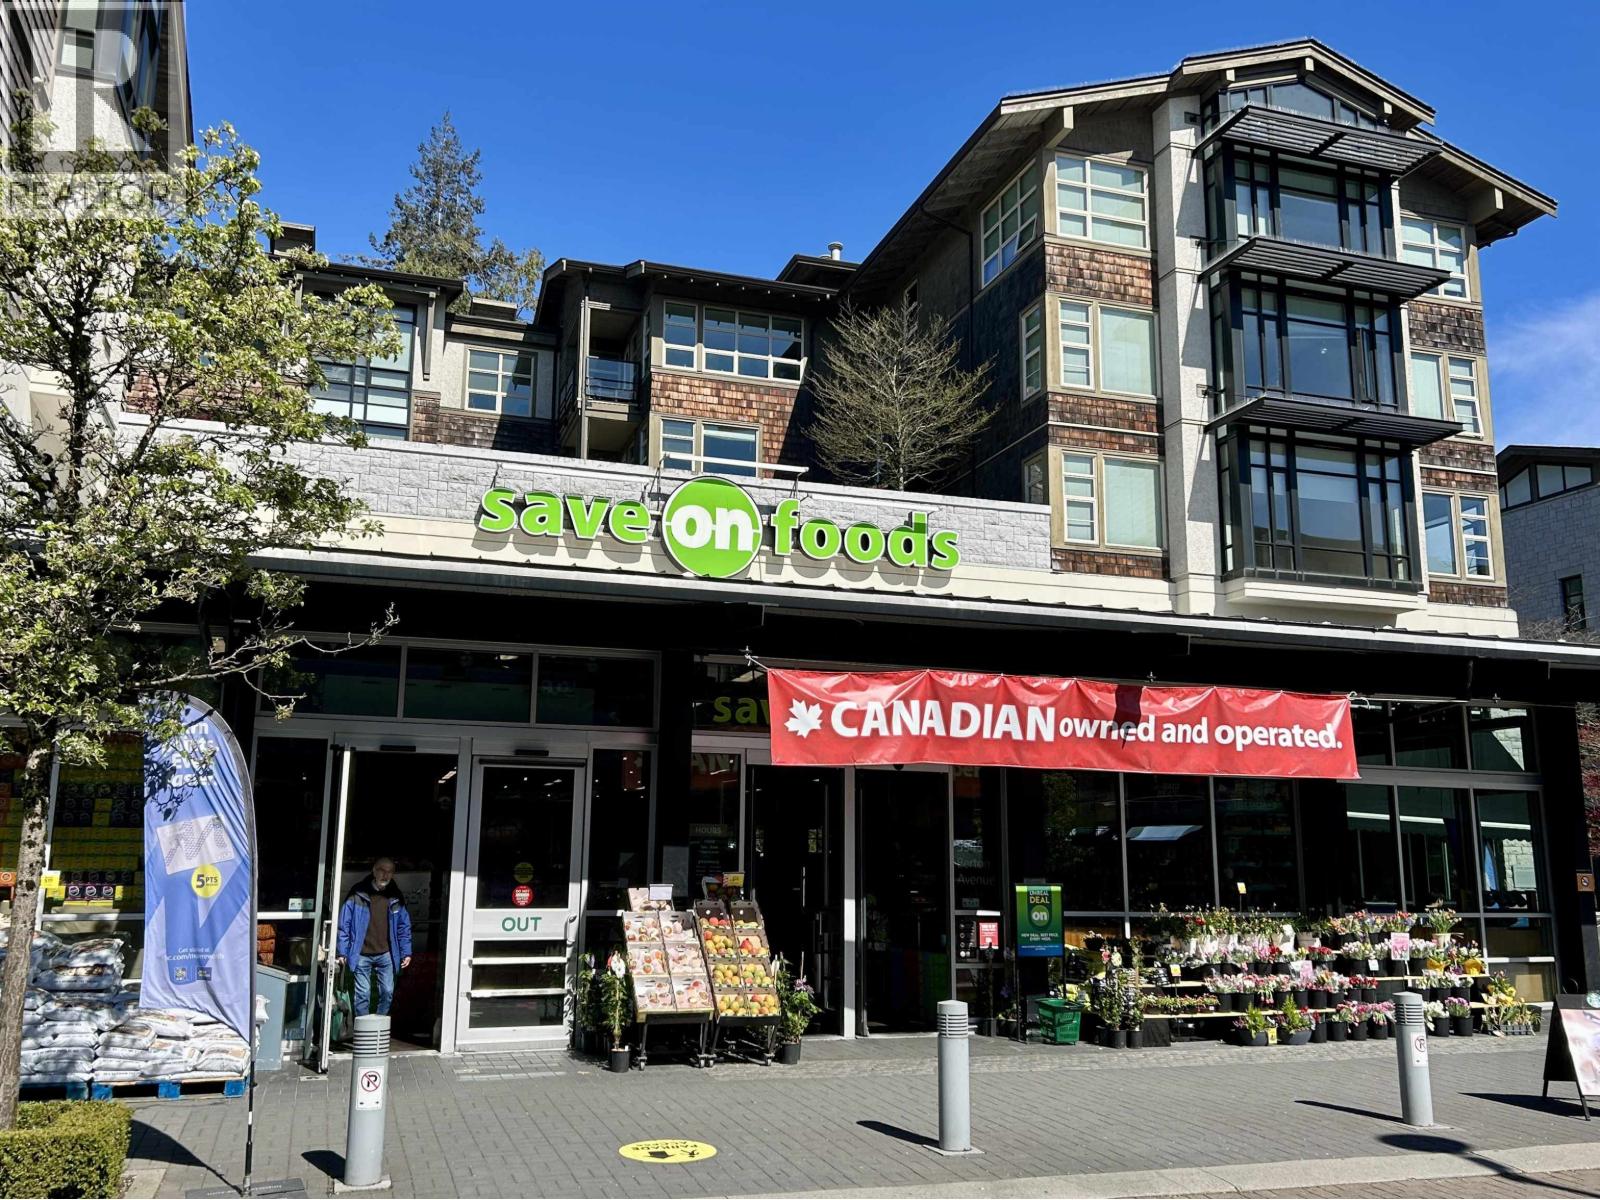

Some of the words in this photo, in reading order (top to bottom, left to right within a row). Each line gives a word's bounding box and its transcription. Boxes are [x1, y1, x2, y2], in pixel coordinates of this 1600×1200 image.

[478, 487, 652, 544] save
[670, 504, 754, 552] on
[770, 498, 961, 570] foods
[831, 699, 1055, 742] CANADIAN
[1059, 715, 1155, 742] owned
[1161, 717, 1208, 744] and
[1214, 723, 1343, 751] operated.
[196, 874, 206, 888] 5
[1029, 896, 1050, 904] DEAL
[1032, 911, 1048, 920] on
[501, 917, 542, 931] OUT
